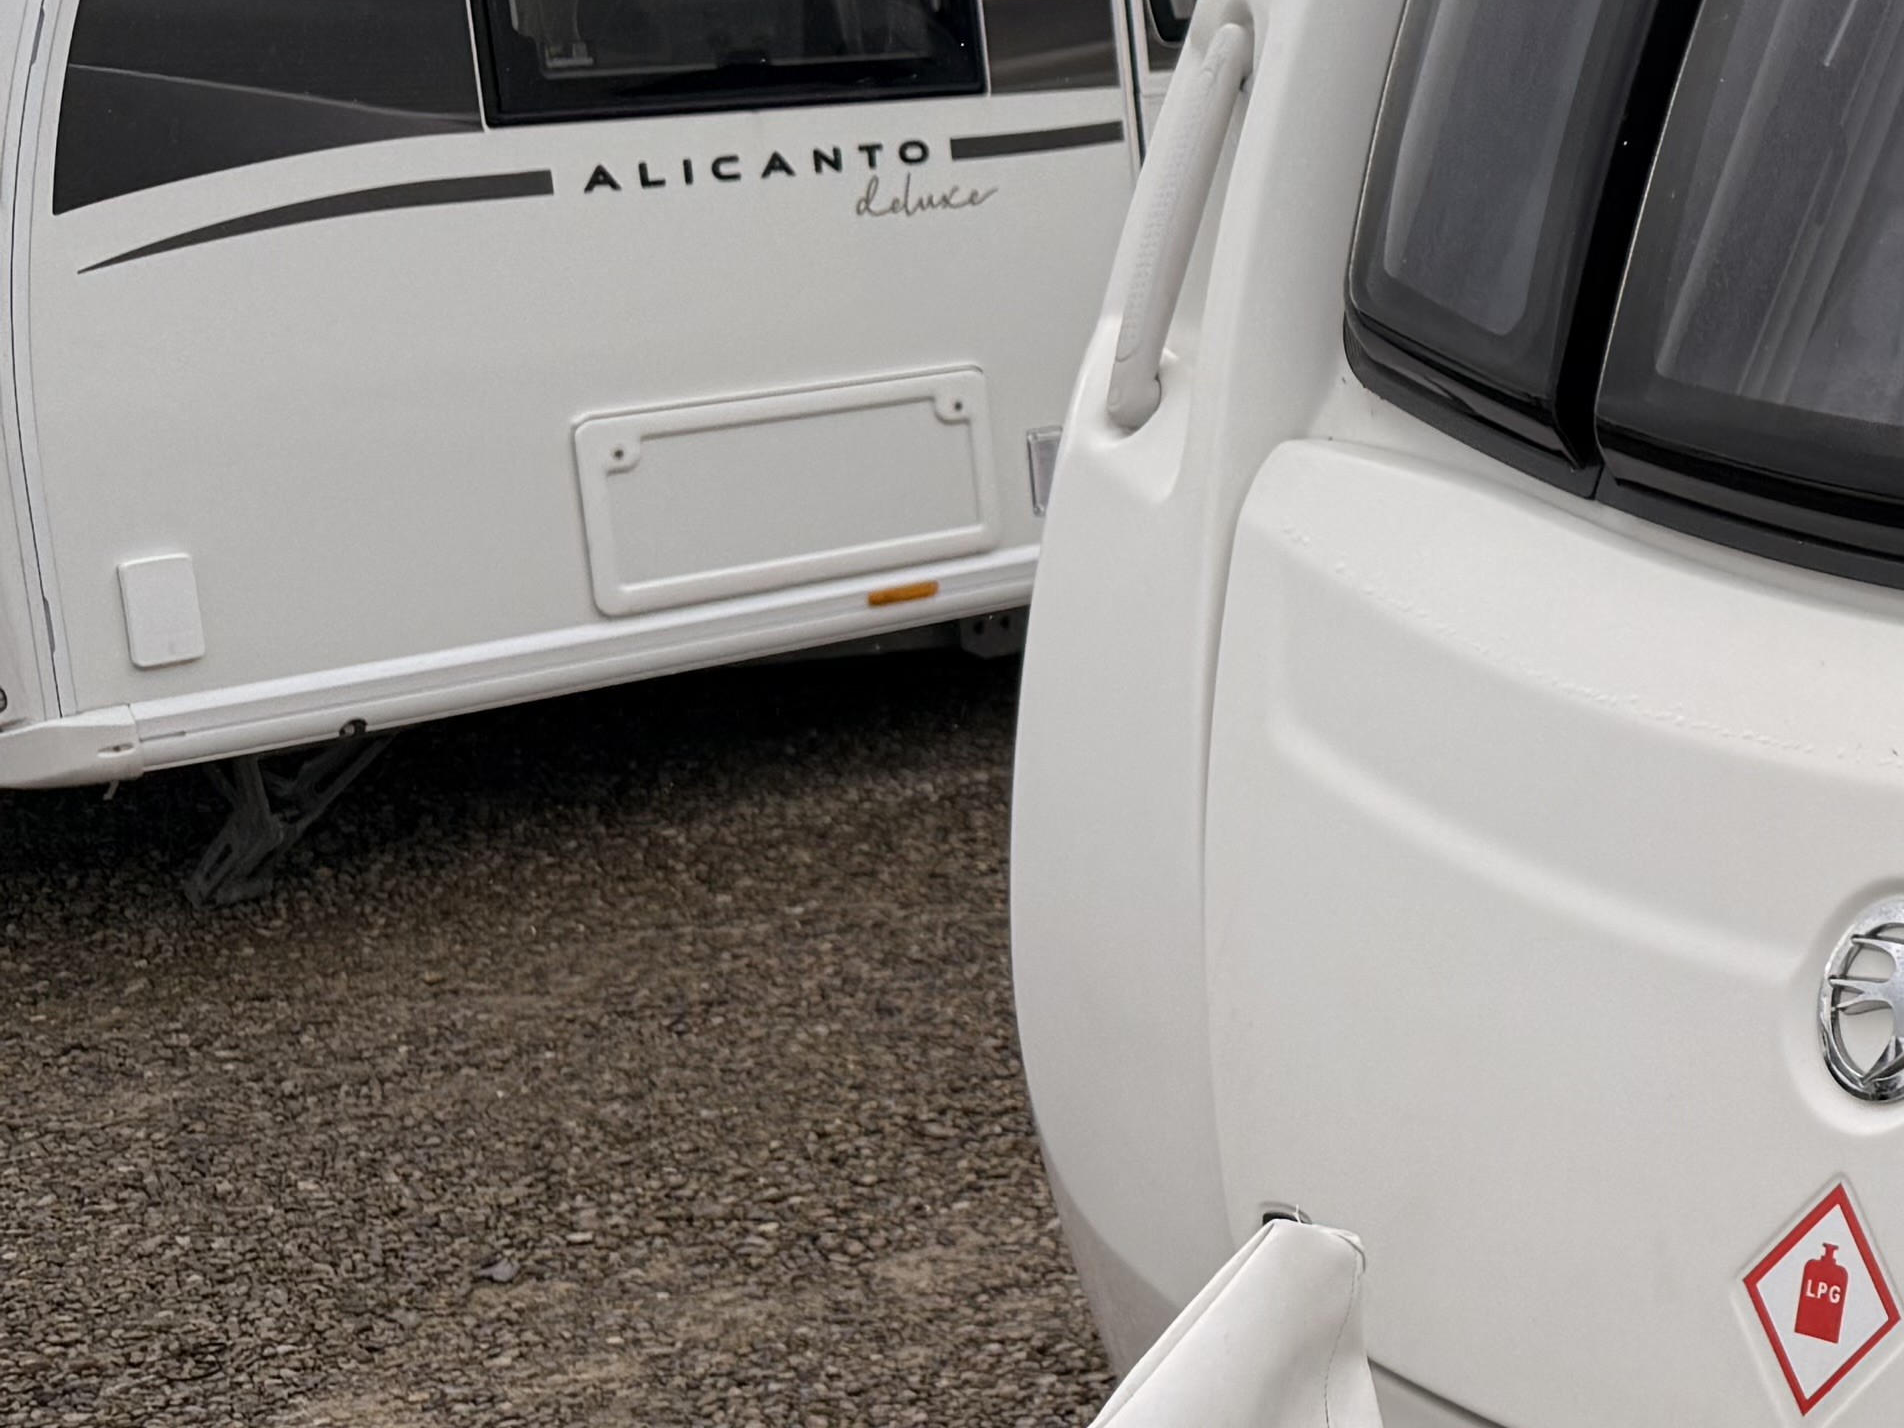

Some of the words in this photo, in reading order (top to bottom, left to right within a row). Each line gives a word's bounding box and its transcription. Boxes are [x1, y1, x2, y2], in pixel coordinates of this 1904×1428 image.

[582, 137, 931, 194] ALICANTO
[855, 172, 1000, 216] deluxe
[1806, 1279, 1841, 1304] LPG
